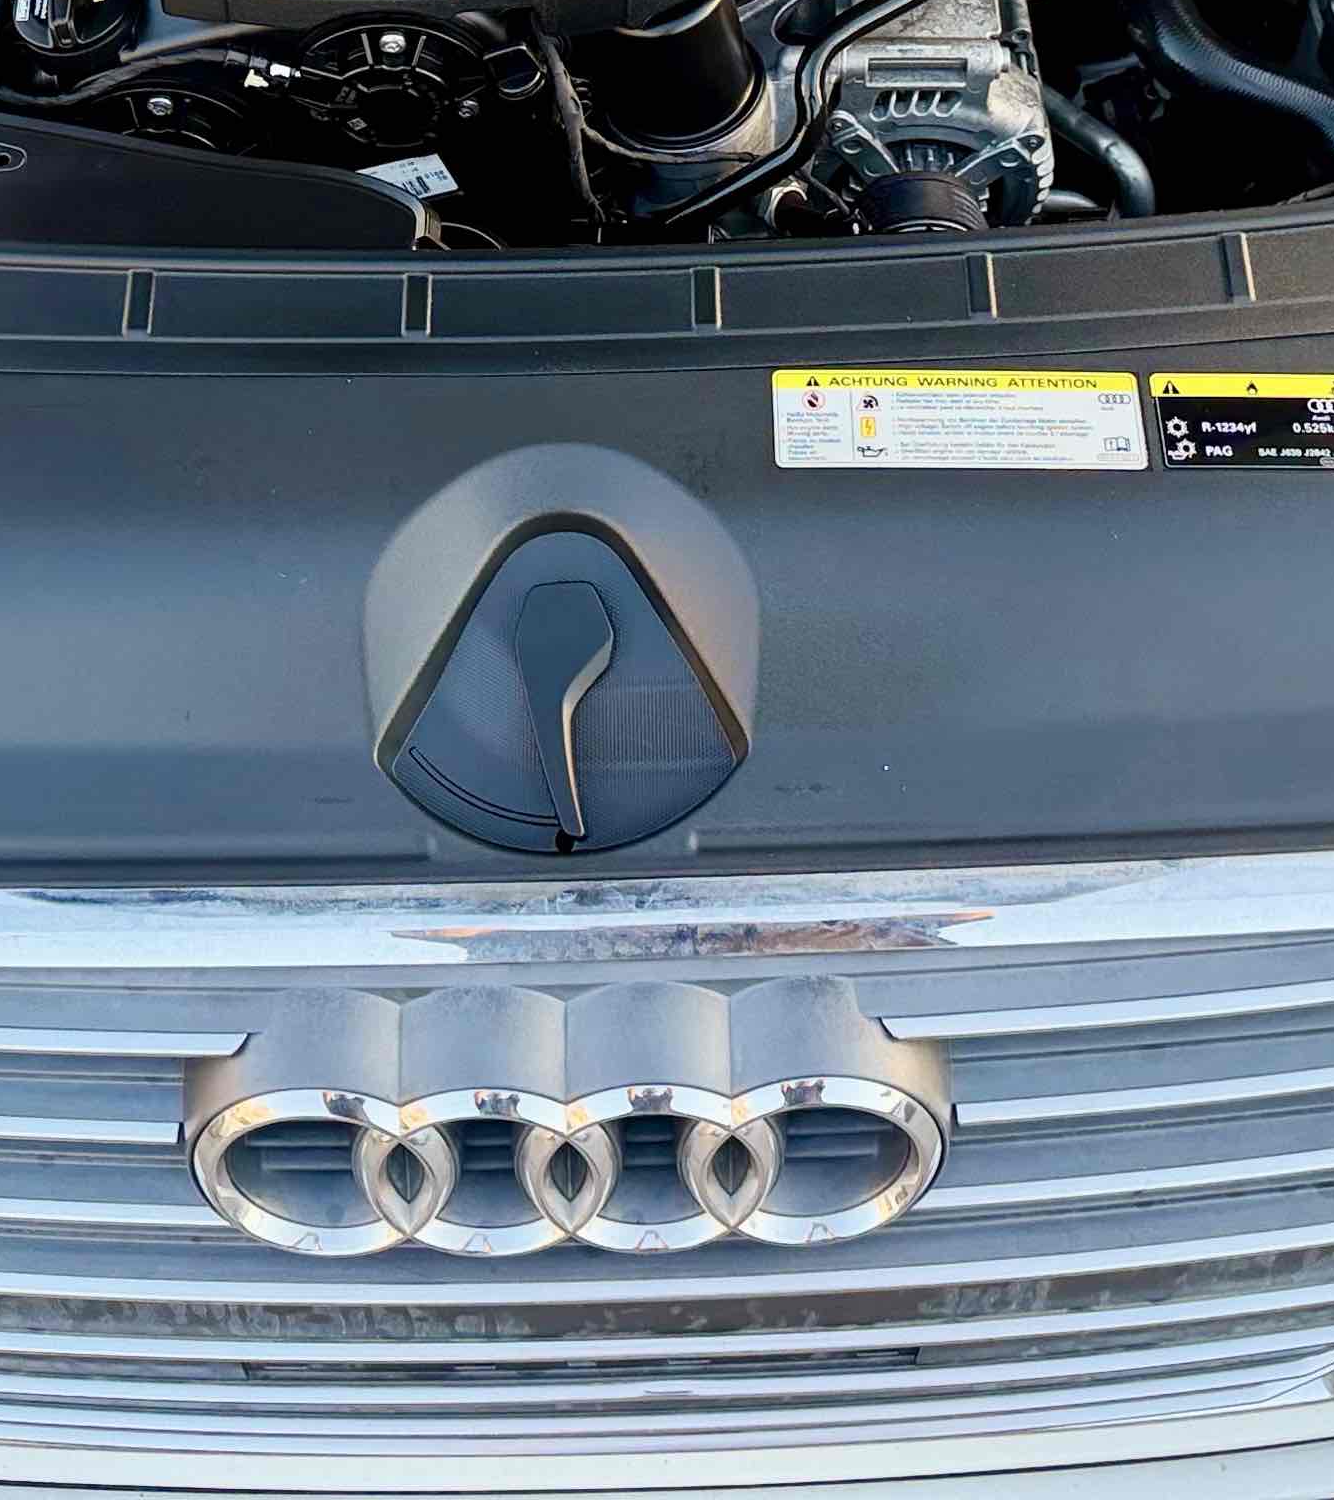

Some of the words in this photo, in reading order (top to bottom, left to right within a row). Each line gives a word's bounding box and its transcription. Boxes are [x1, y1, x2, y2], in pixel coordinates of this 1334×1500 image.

[829, 376, 907, 387] ACHTUNG
[918, 377, 997, 388] WARNING
[1008, 378, 1097, 389] ATTENTION
[1205, 445, 1234, 457] PAG
